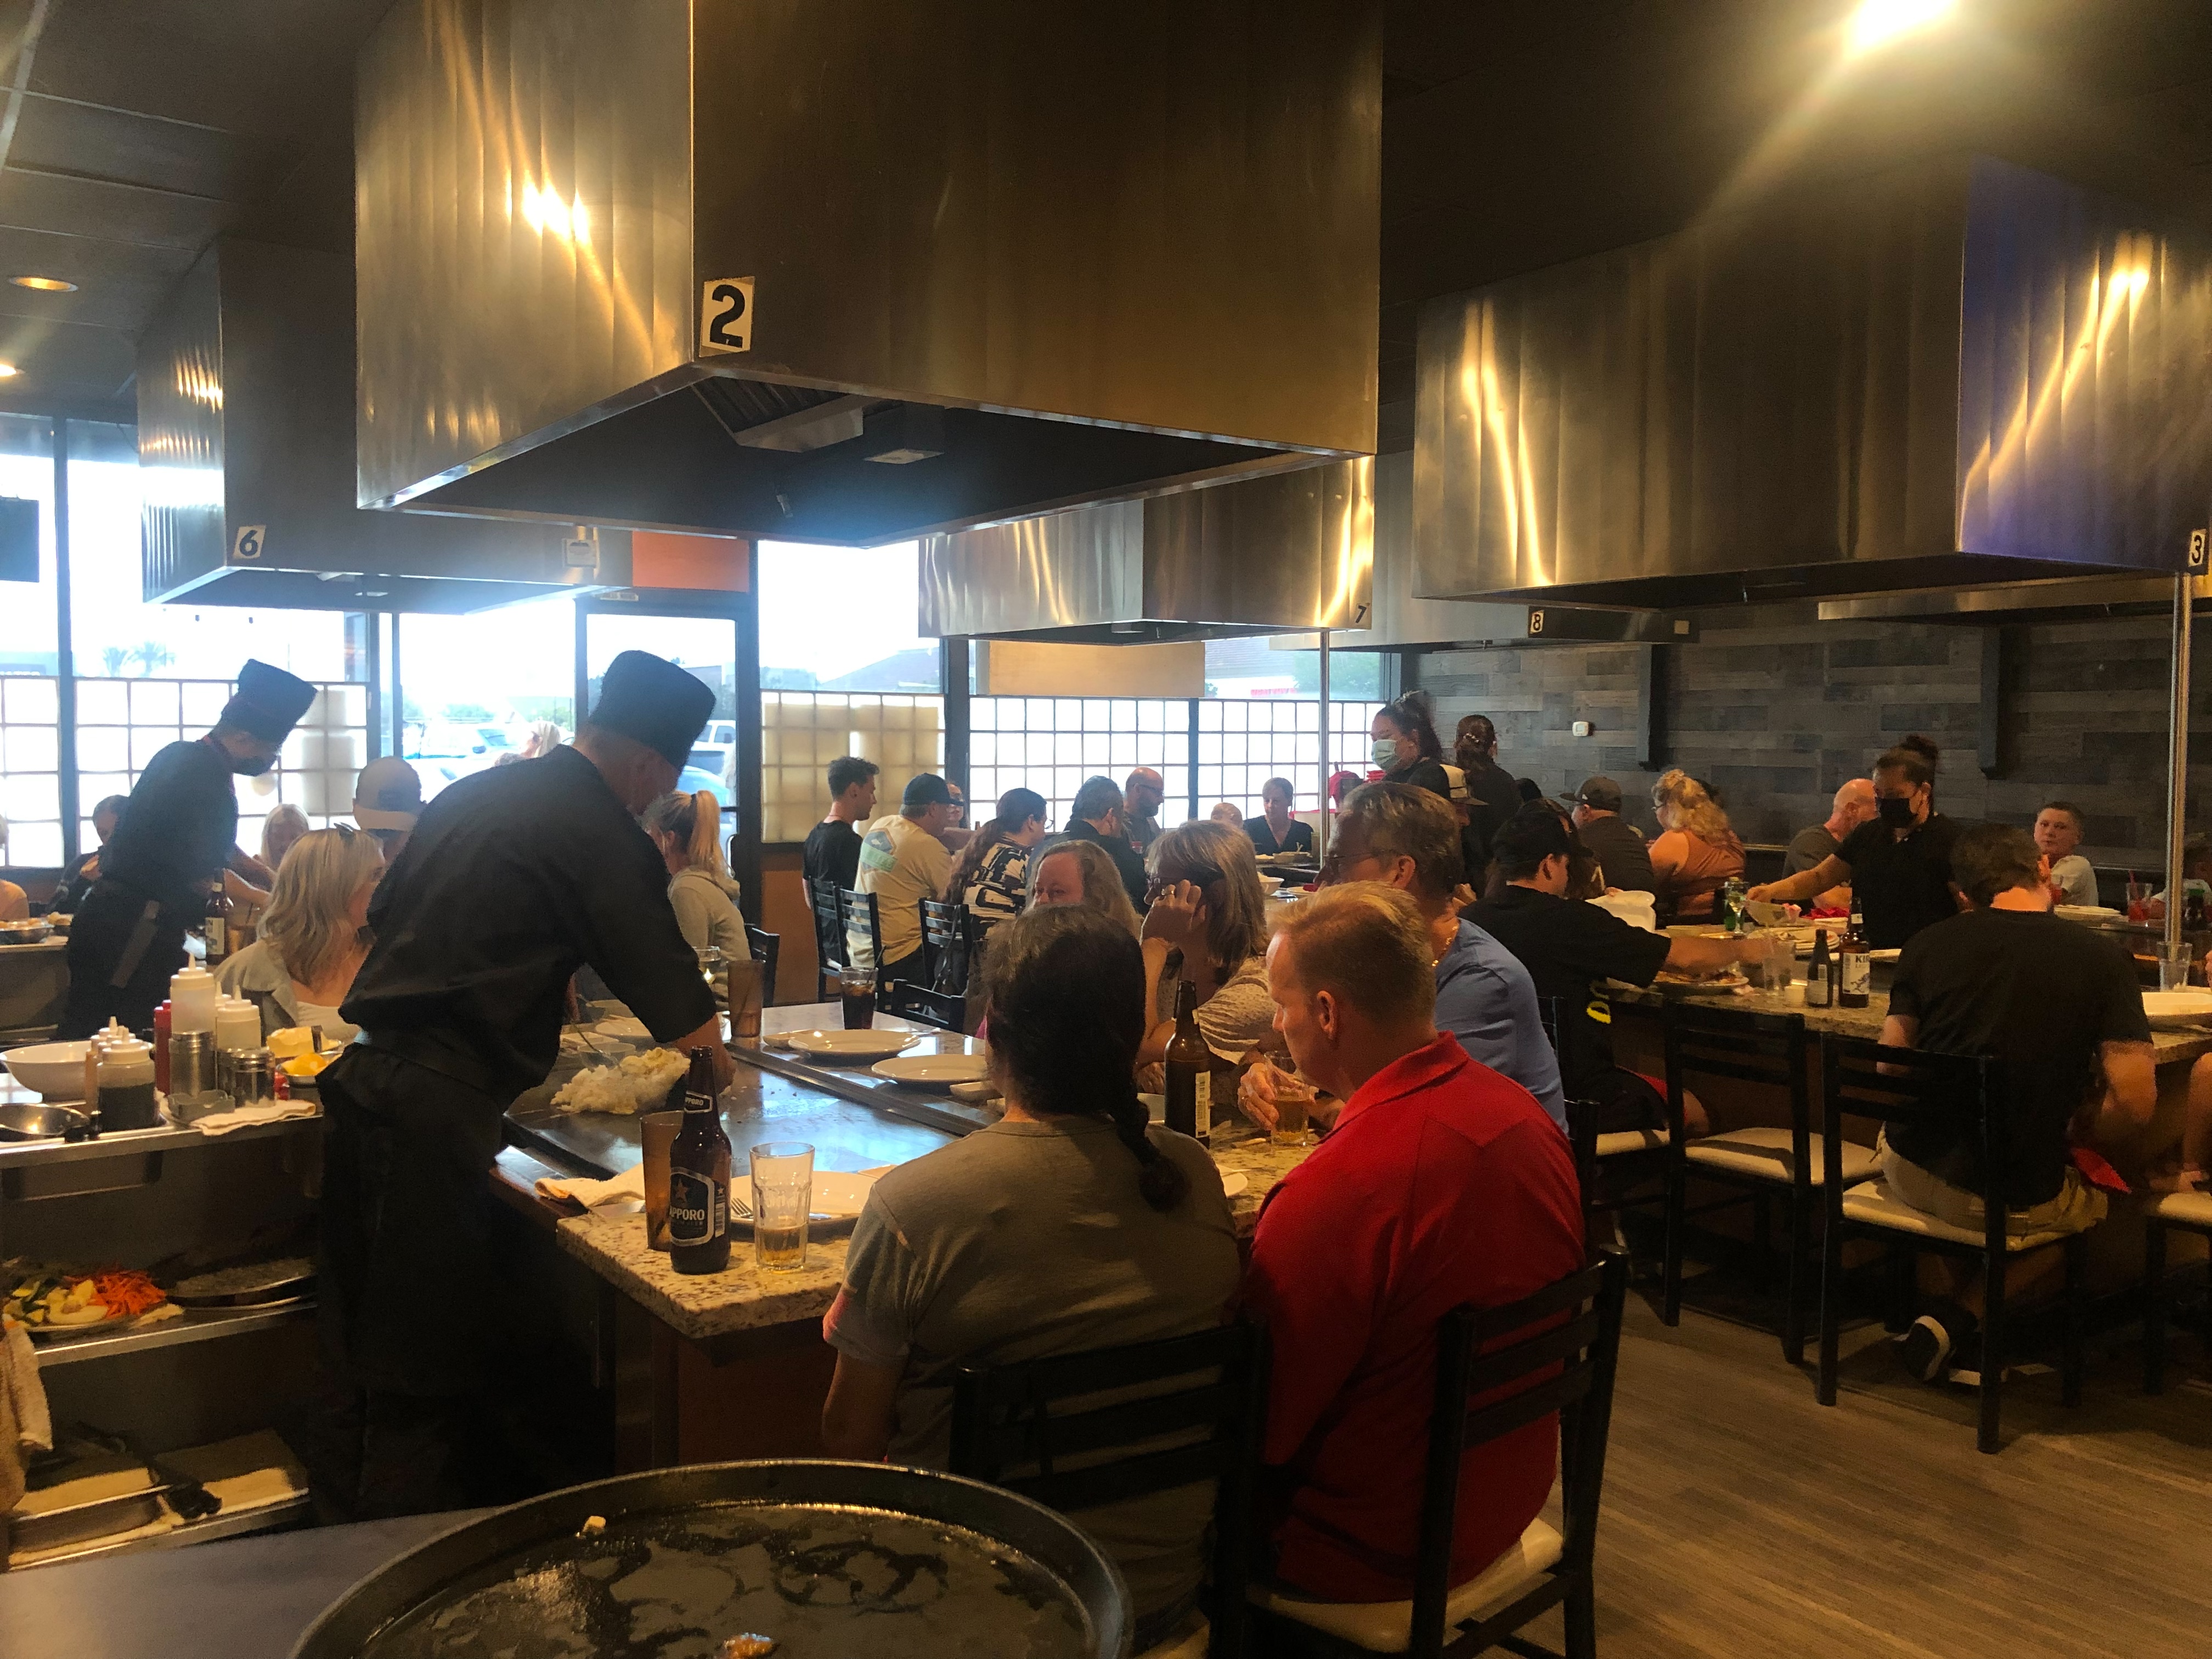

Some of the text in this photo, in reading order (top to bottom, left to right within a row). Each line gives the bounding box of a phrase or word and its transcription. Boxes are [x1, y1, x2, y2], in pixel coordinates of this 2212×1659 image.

[710, 284, 745, 348] 2
[239, 530, 258, 556] 6
[2192, 535, 2202, 563] 3
[1355, 605, 1367, 623] 7
[1533, 614, 1541, 630] 8
